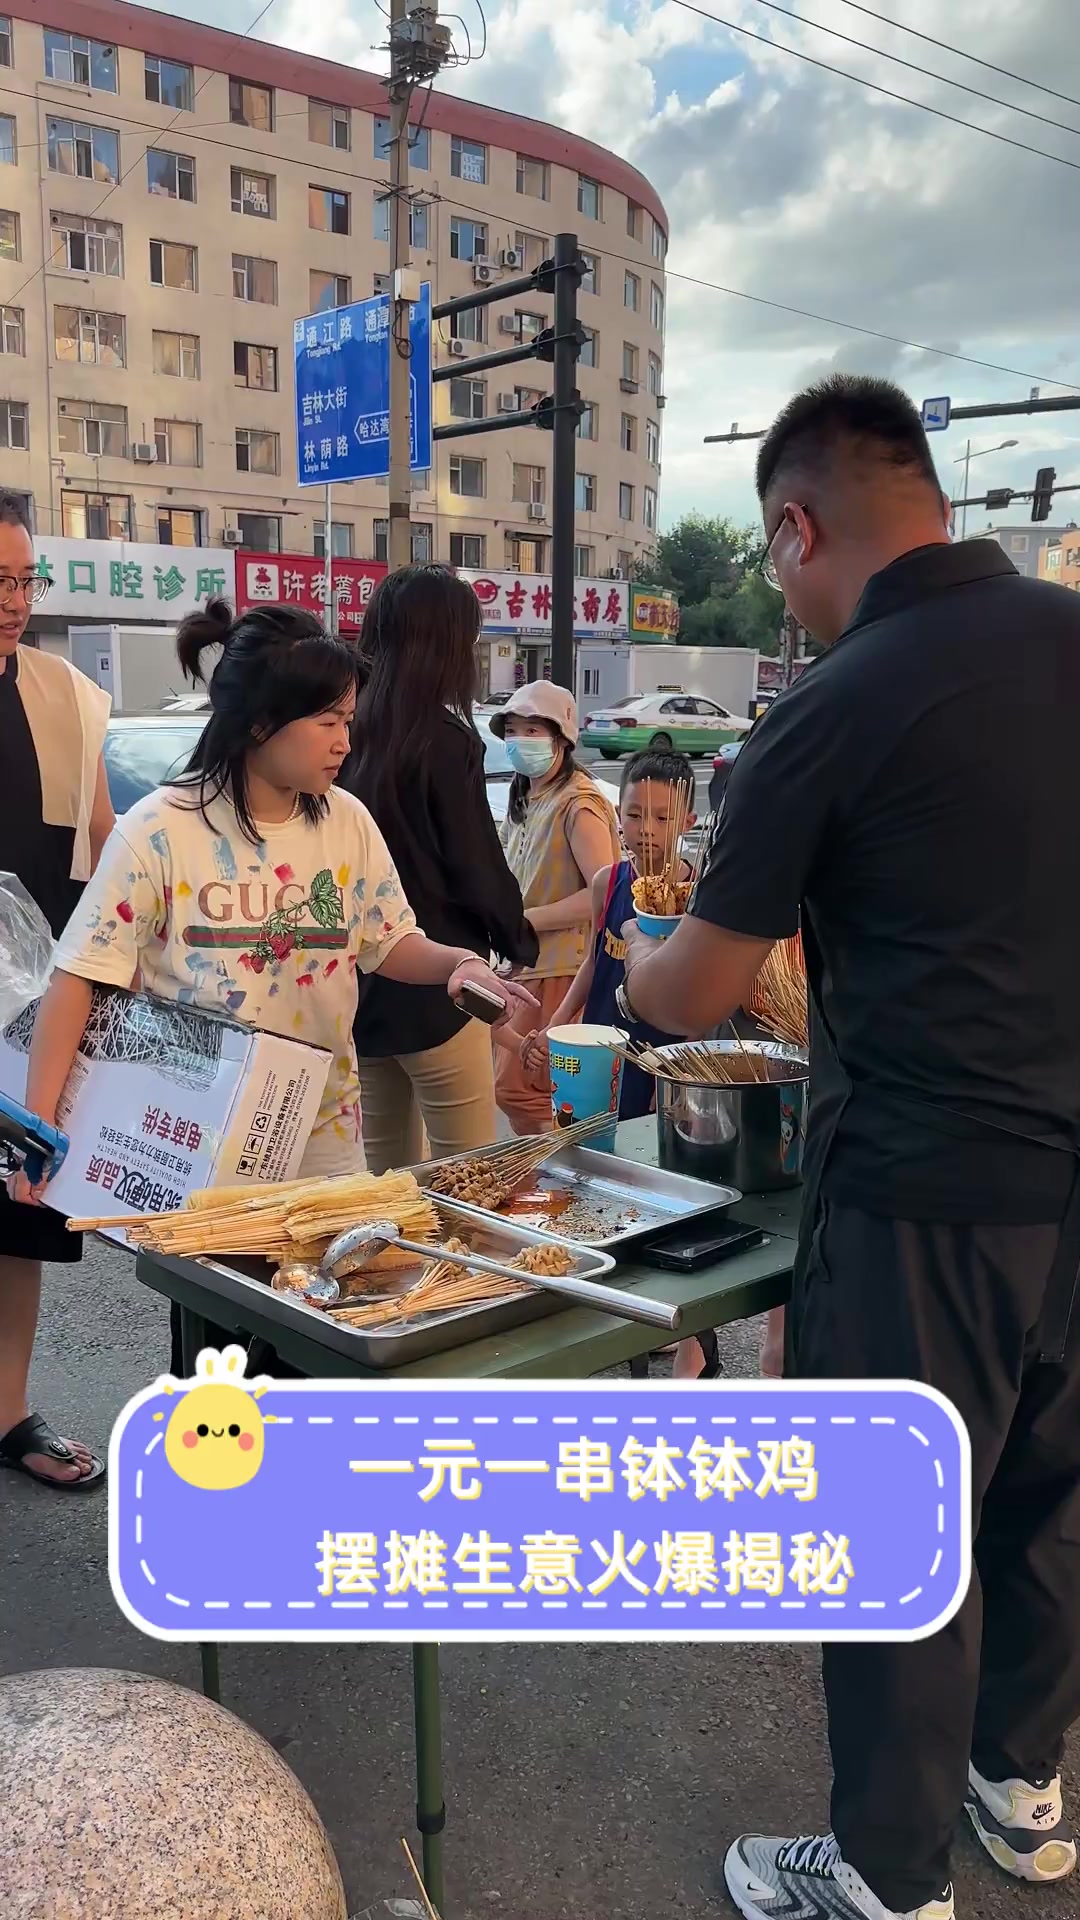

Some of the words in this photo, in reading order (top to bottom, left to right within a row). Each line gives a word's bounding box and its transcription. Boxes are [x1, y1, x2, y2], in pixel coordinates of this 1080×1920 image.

[306, 315, 351, 348] 通江路
[306, 346, 330, 359] Tongjiang
[302, 386, 348, 415] 吉林大街
[359, 417, 390, 438] 哈达湾
[304, 435, 349, 463] 林荫路
[304, 464, 319, 474] Linyin
[505, 581, 622, 624] 吉林药房
[198, 882, 345, 923] GUC
[550, 1052, 580, 1076] 串串
[142, 1105, 202, 1152] 电商专供
[257, 1079, 297, 1179] 广东统用卫浴设备有限公司
[97, 1143, 117, 1157] HEALTH
[99, 1125, 193, 1176] 统用卫厨致力为您生活轻松
[118, 1152, 130, 1161] AND
[131, 1158, 149, 1171] SAFETY
[150, 1166, 173, 1182] QUALITY
[173, 1177, 187, 1188] HIGH
[1036, 1802, 1053, 1814] NIKE
